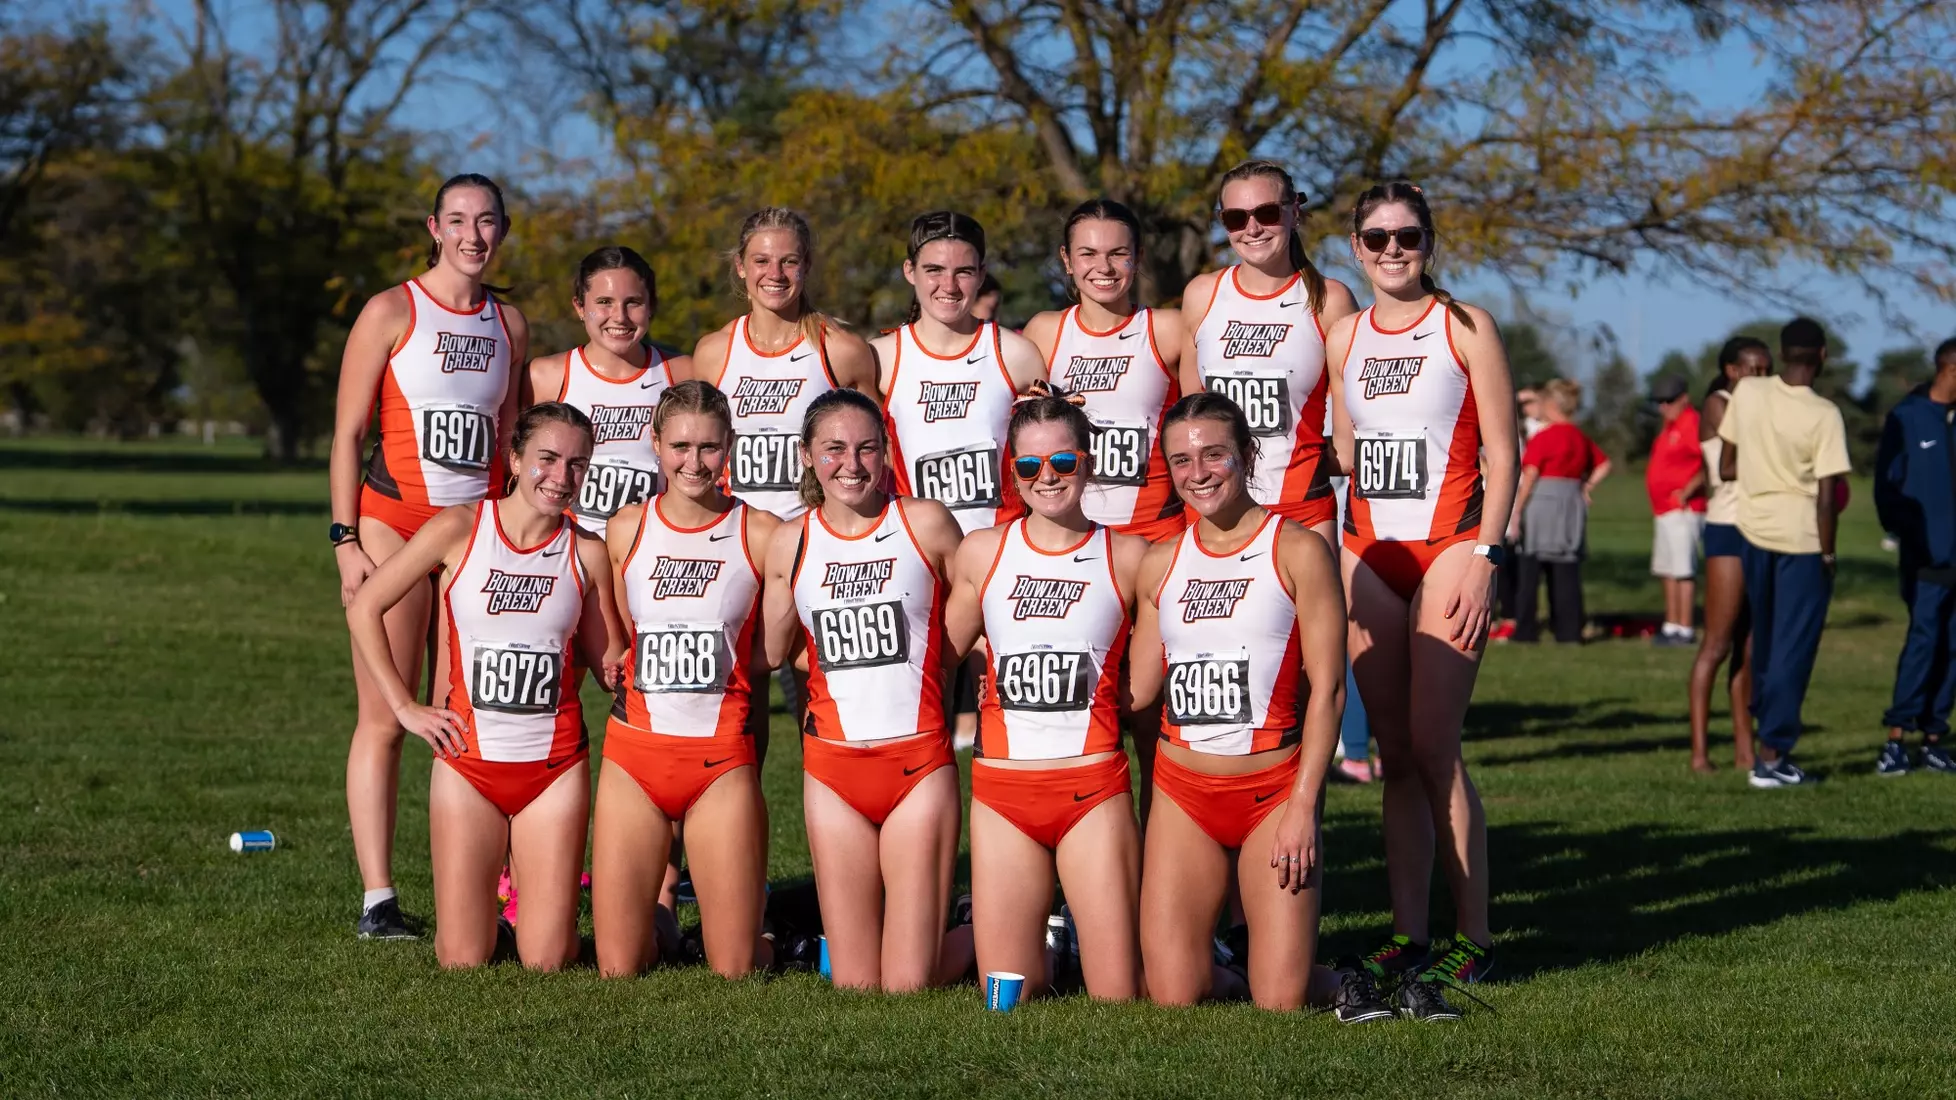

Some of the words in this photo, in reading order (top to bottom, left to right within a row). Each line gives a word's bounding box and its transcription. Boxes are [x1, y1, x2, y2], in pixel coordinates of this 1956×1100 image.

[1223, 322, 1286, 340] BOWLING
[438, 333, 494, 355] BOWLING
[1225, 339, 1276, 358] GREEN
[444, 352, 489, 372] GREEN
[1068, 356, 1129, 375] BOWLING
[1362, 358, 1420, 379] BOWLING
[735, 377, 801, 396] BOWLING
[920, 382, 976, 402] BOWLING
[1072, 373, 1120, 392] GREEN
[1366, 375, 1411, 398] GREEN
[591, 406, 652, 424] BOWLING
[738, 396, 790, 416] GREEN
[926, 400, 968, 422] GREEN
[429, 411, 490, 463] 6971
[595, 423, 643, 443] GREEN
[736, 435, 804, 484] 6970
[1090, 428, 1139, 477] 963
[1360, 440, 1418, 490] 6974
[579, 465, 652, 513] 6973
[922, 452, 995, 504] 6964
[652, 557, 718, 580] BOWLING
[825, 560, 891, 584] BOWLING
[485, 570, 552, 594] BOWLING
[655, 578, 708, 598] GREEN
[834, 578, 884, 599] GREEN
[1012, 577, 1084, 600] BOWLING
[1182, 580, 1248, 600] BOWLING
[490, 592, 543, 613] GREEN
[1016, 598, 1072, 619] GREEN
[1184, 598, 1236, 622] GREEN
[820, 604, 898, 662] 6969
[642, 632, 716, 685] 6968
[479, 649, 554, 705] 6972
[1003, 653, 1080, 704] 6967
[1170, 662, 1242, 716] 6966
